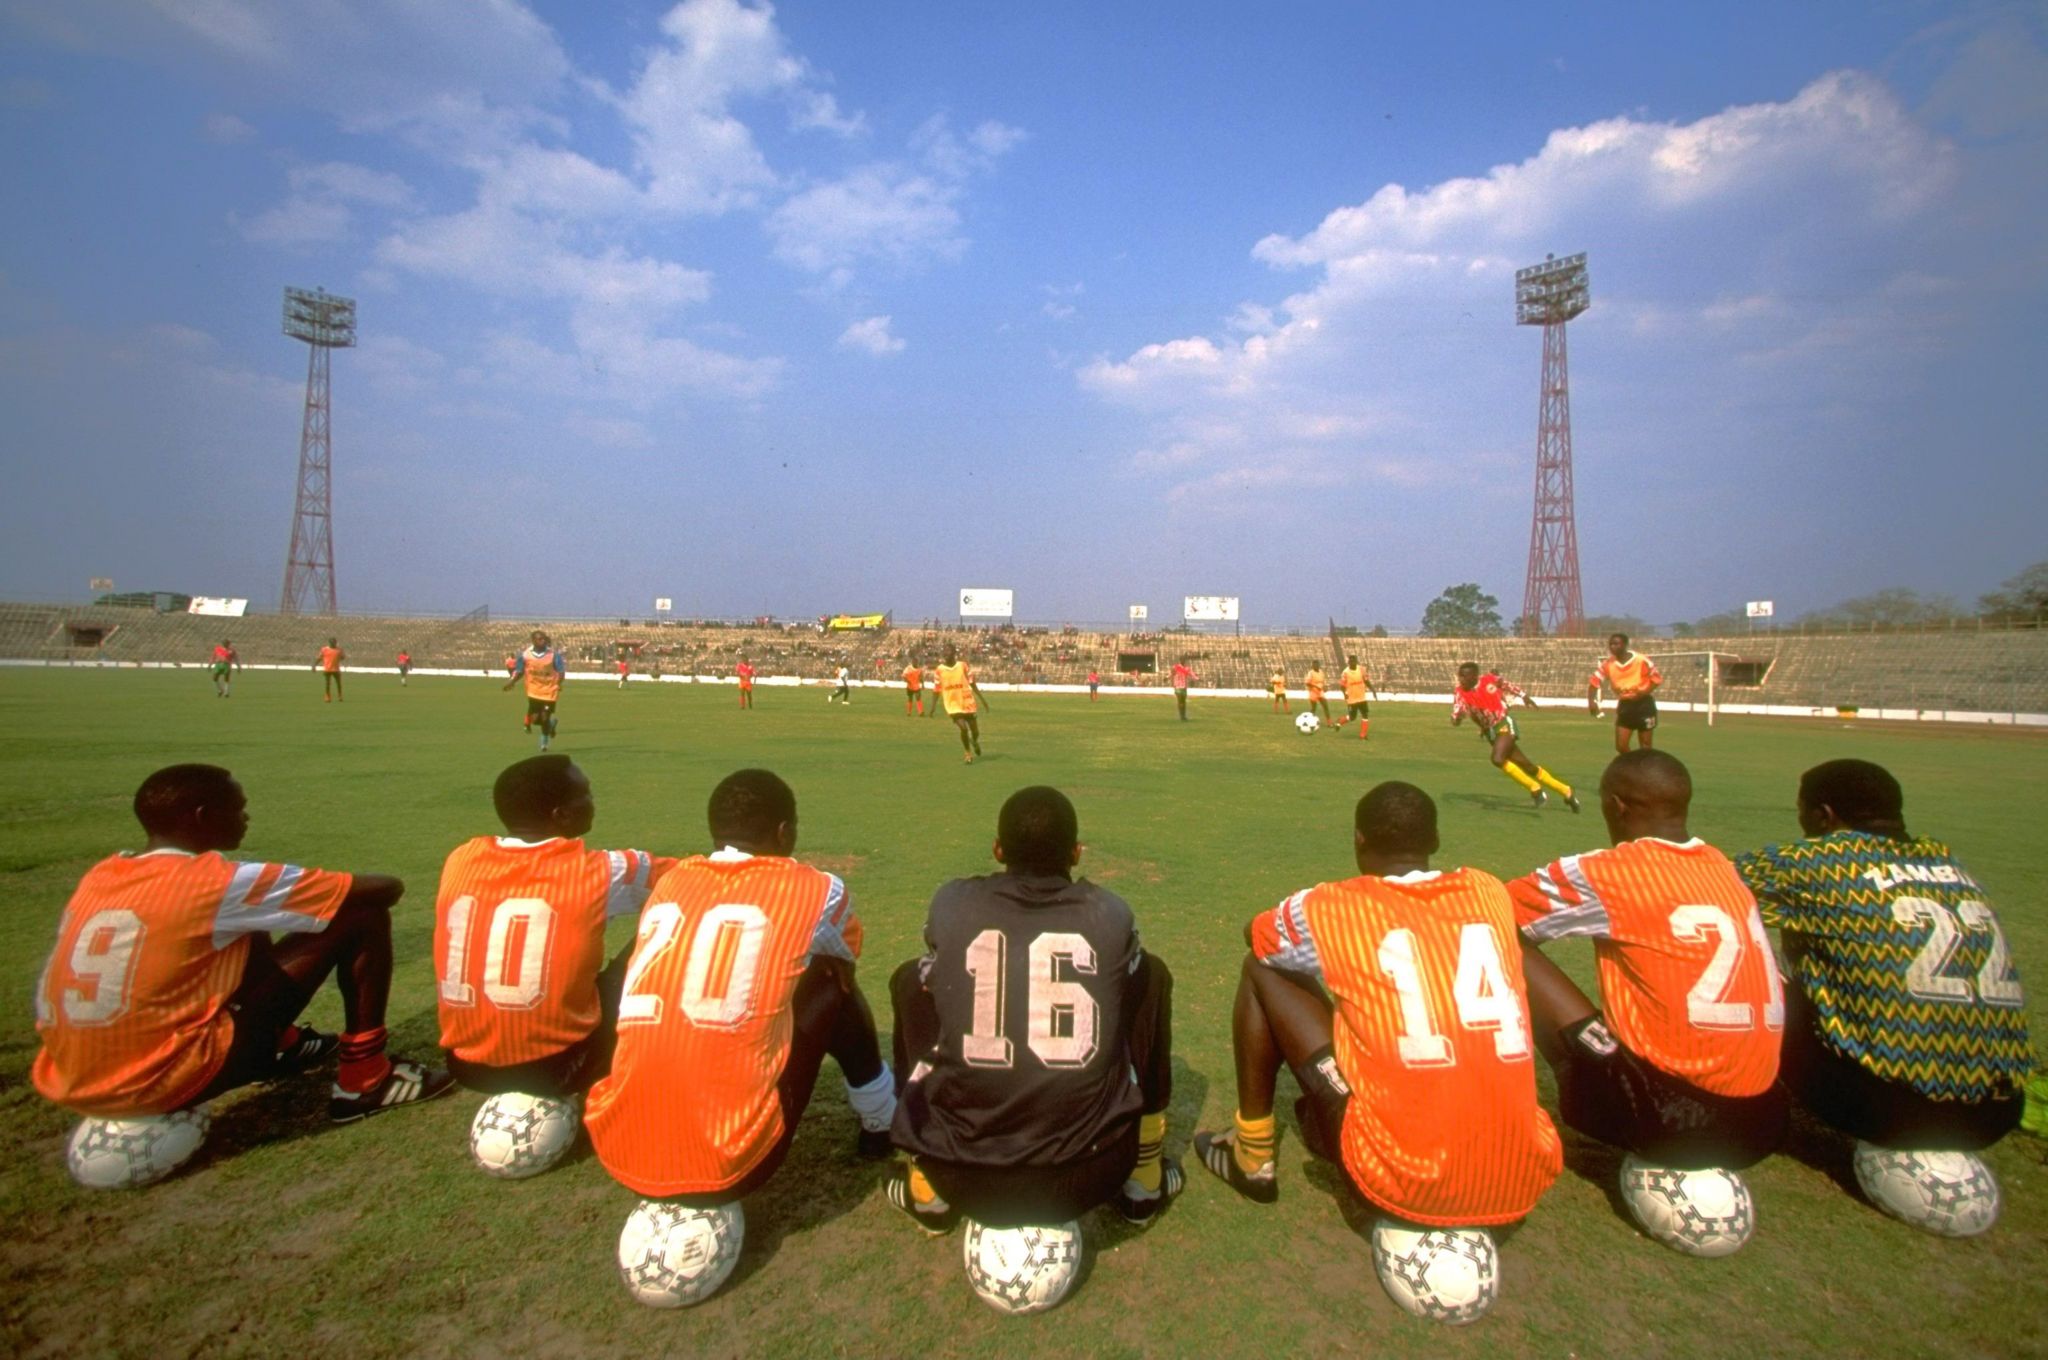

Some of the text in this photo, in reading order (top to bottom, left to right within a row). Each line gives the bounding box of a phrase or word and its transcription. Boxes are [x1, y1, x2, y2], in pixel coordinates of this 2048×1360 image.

[441, 895, 558, 1011] 10
[617, 901, 772, 1030] 20
[963, 929, 1100, 1069] 16
[1377, 923, 1531, 1069] 14
[1891, 896, 2024, 1006] 22
